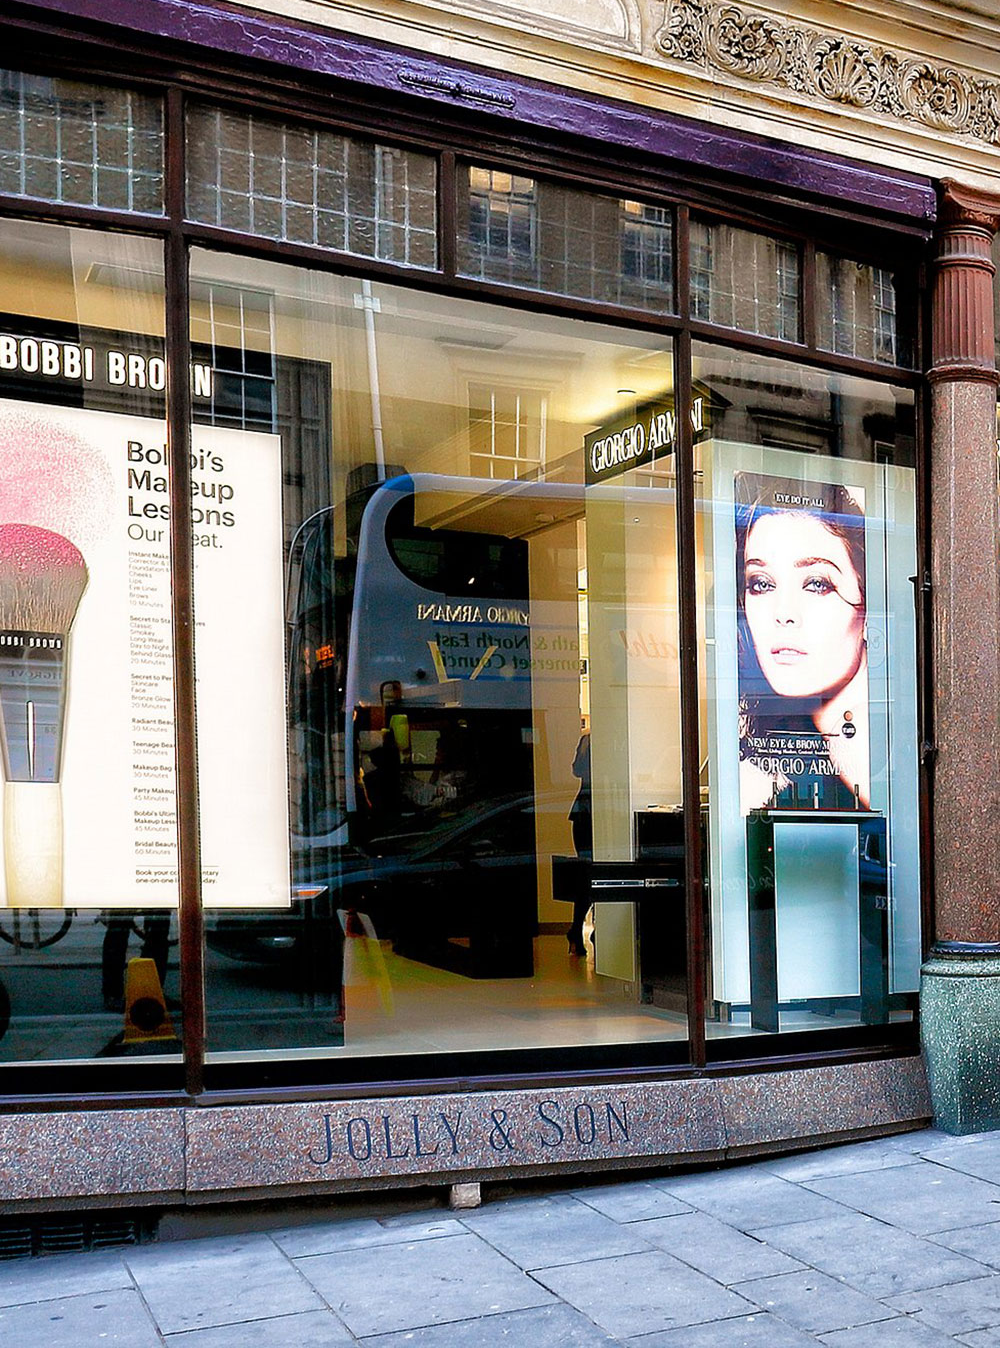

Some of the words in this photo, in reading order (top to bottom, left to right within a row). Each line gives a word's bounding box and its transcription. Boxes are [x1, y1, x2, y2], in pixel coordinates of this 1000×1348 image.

[0, 335, 94, 382] BOBBI
[107, 351, 212, 398] BRON
[591, 423, 645, 473] GIORGIO
[648, 397, 703, 452] ARMNI
[127, 440, 224, 473] Boi's
[127, 467, 234, 504] Maeup
[776, 493, 790, 504] EYE
[791, 495, 801, 505] DO
[811, 498, 825, 508] ALL
[127, 495, 235, 527] Lesons
[127, 523, 165, 542] Our
[192, 533, 223, 549] eat.
[0, 636, 23, 647] OBBI
[747, 737, 768, 748] NEW
[769, 737, 787, 748] EYE
[796, 739, 820, 750] BROW
[308, 1111, 463, 1166] JOLLY
[488, 1108, 515, 1151] &
[538, 1099, 631, 1149] SON
